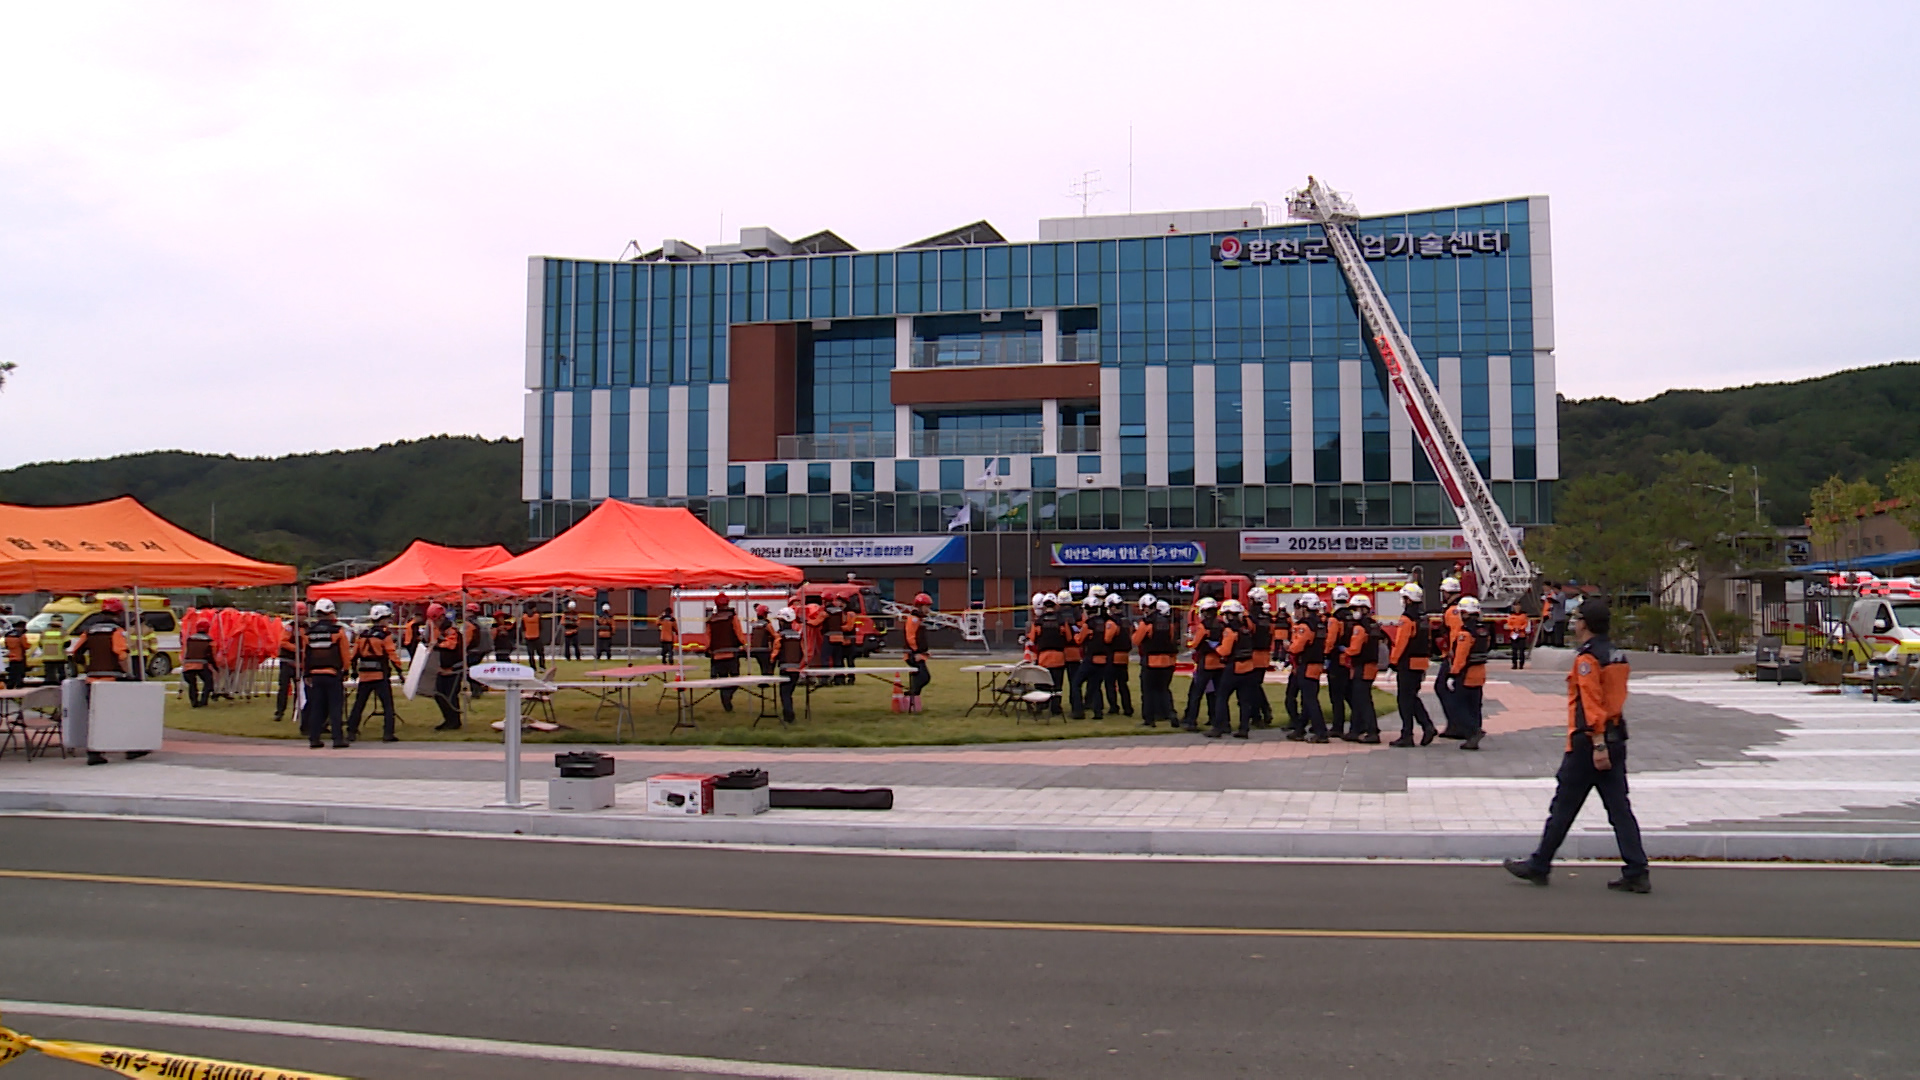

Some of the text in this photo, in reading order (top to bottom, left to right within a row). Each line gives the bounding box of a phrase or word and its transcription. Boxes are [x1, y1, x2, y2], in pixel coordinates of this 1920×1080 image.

[1248, 229, 1502, 264] 합천군 업기술센터
[7, 537, 167, 552] 합천소방서
[1288, 537, 1341, 550] 2025년
[1345, 536, 1388, 550] 합천군
[1391, 535, 1469, 550] 안전한국훈
[750, 547, 781, 558] 2025년
[784, 546, 832, 558] 합천소방서
